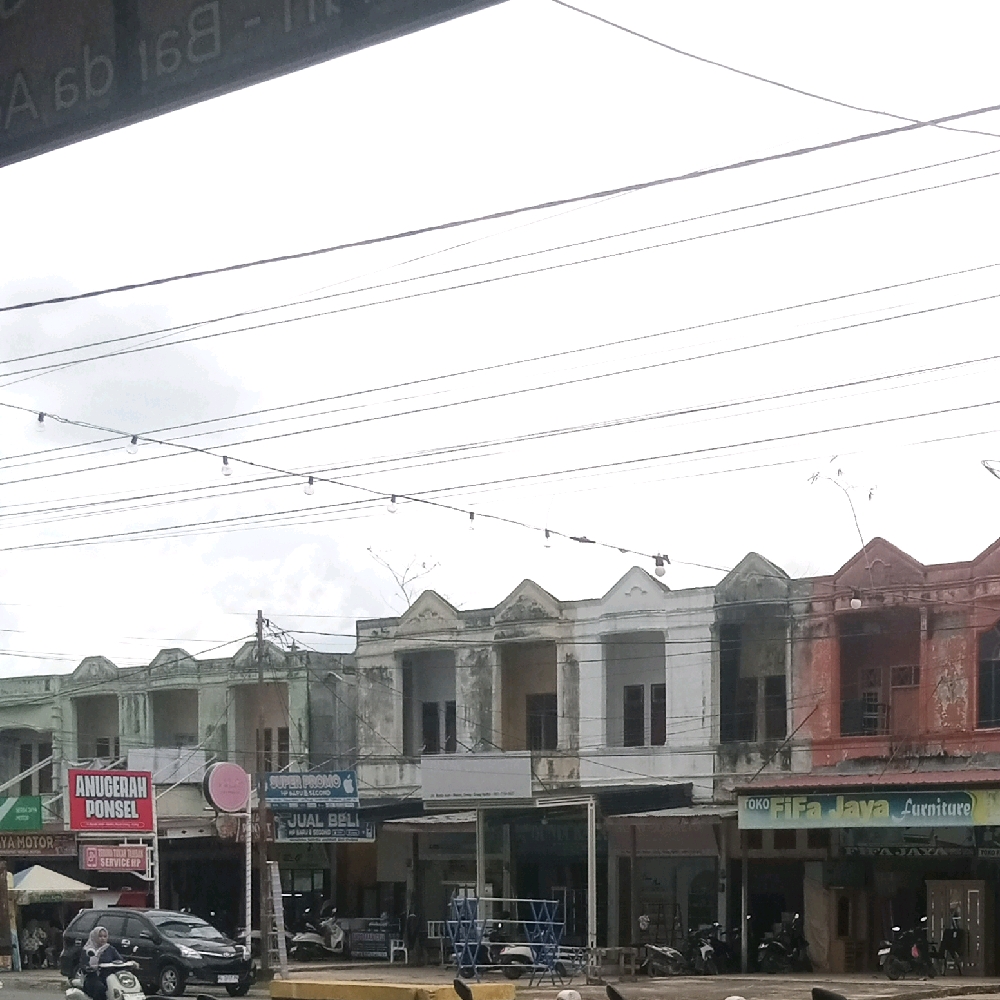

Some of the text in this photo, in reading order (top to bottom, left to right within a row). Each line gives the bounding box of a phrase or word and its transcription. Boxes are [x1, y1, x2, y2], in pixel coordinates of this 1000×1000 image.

[75, 774, 148, 799] ANUGERAH
[269, 773, 342, 789] SUPER PROMO
[85, 800, 140, 819] PONSEL
[744, 796, 769, 810] TOKO
[828, 795, 890, 819] Jaya
[287, 813, 324, 828] JUAL
[328, 811, 360, 827] BELI
[17, 836, 54, 849] MOTOR
[100, 858, 141, 868] SERVICE HP
